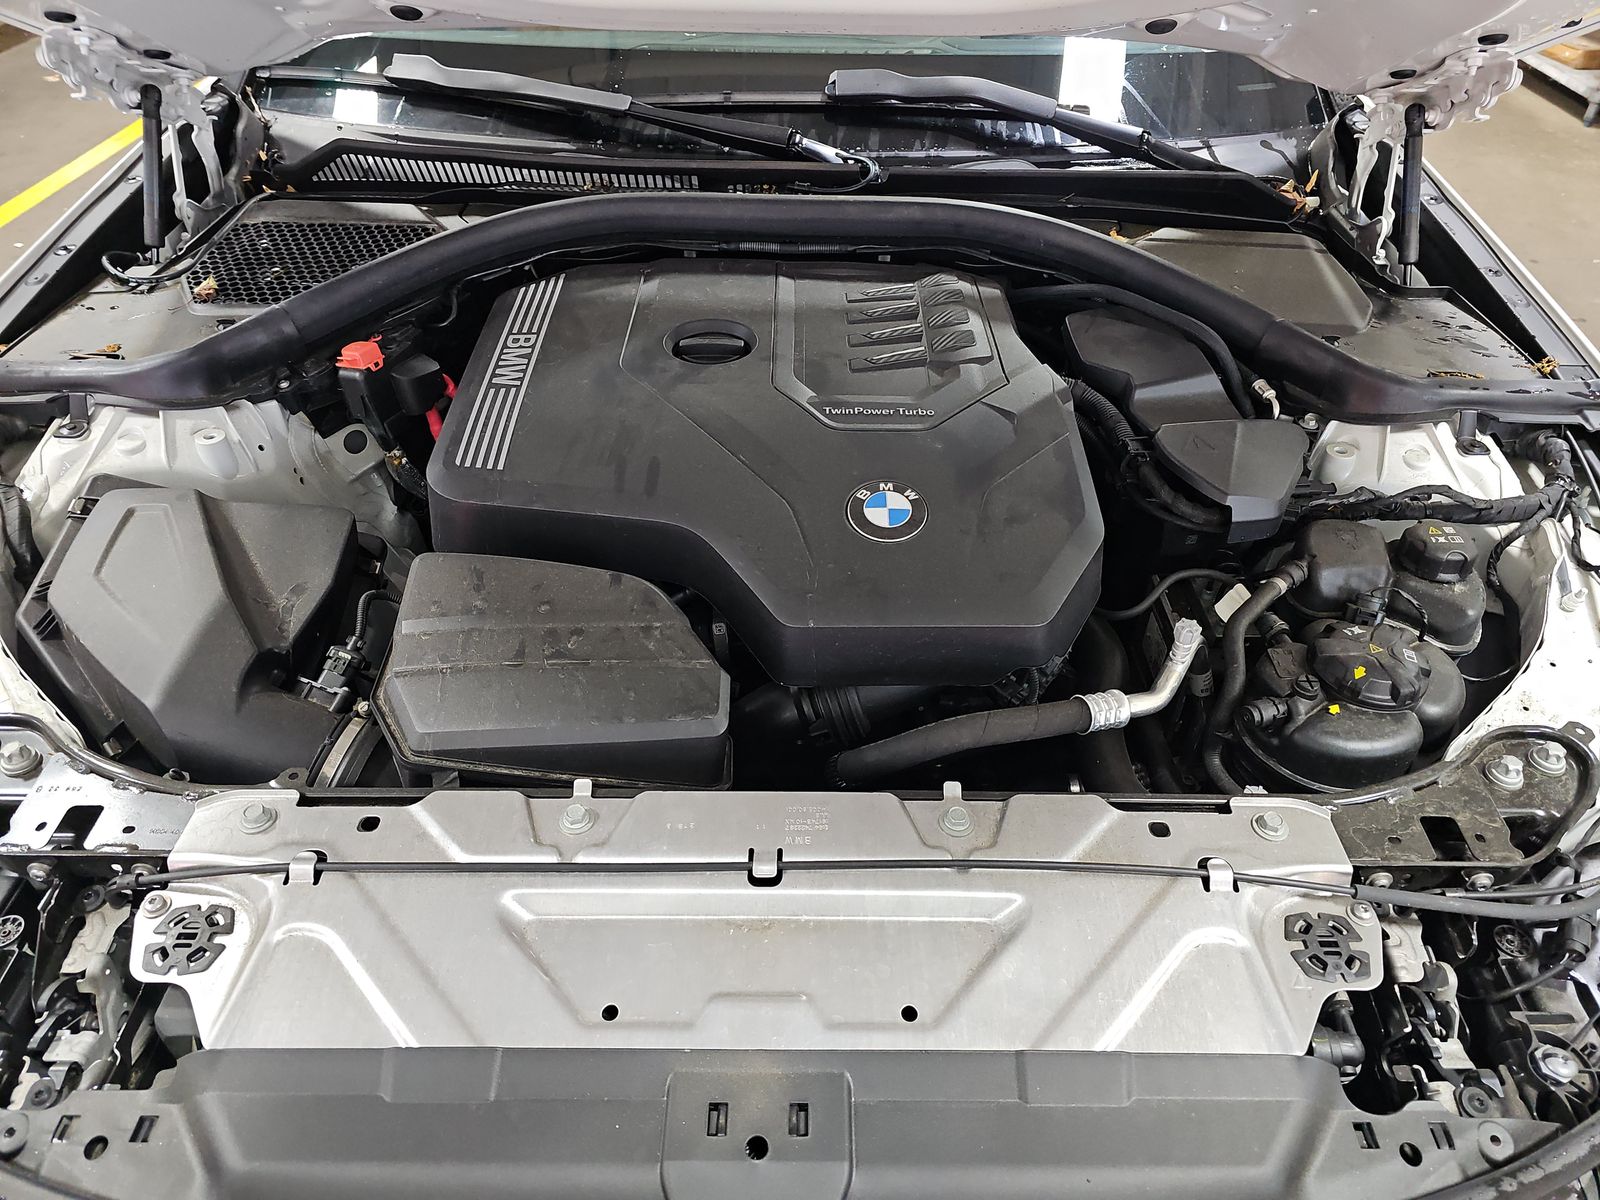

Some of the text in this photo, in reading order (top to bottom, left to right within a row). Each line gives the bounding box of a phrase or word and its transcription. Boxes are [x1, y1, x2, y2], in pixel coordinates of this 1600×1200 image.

[491, 334, 538, 386] BMW
[822, 406, 935, 417] TwinPower Turbo
[855, 482, 919, 500] BMW
[784, 836, 812, 846] BMW
